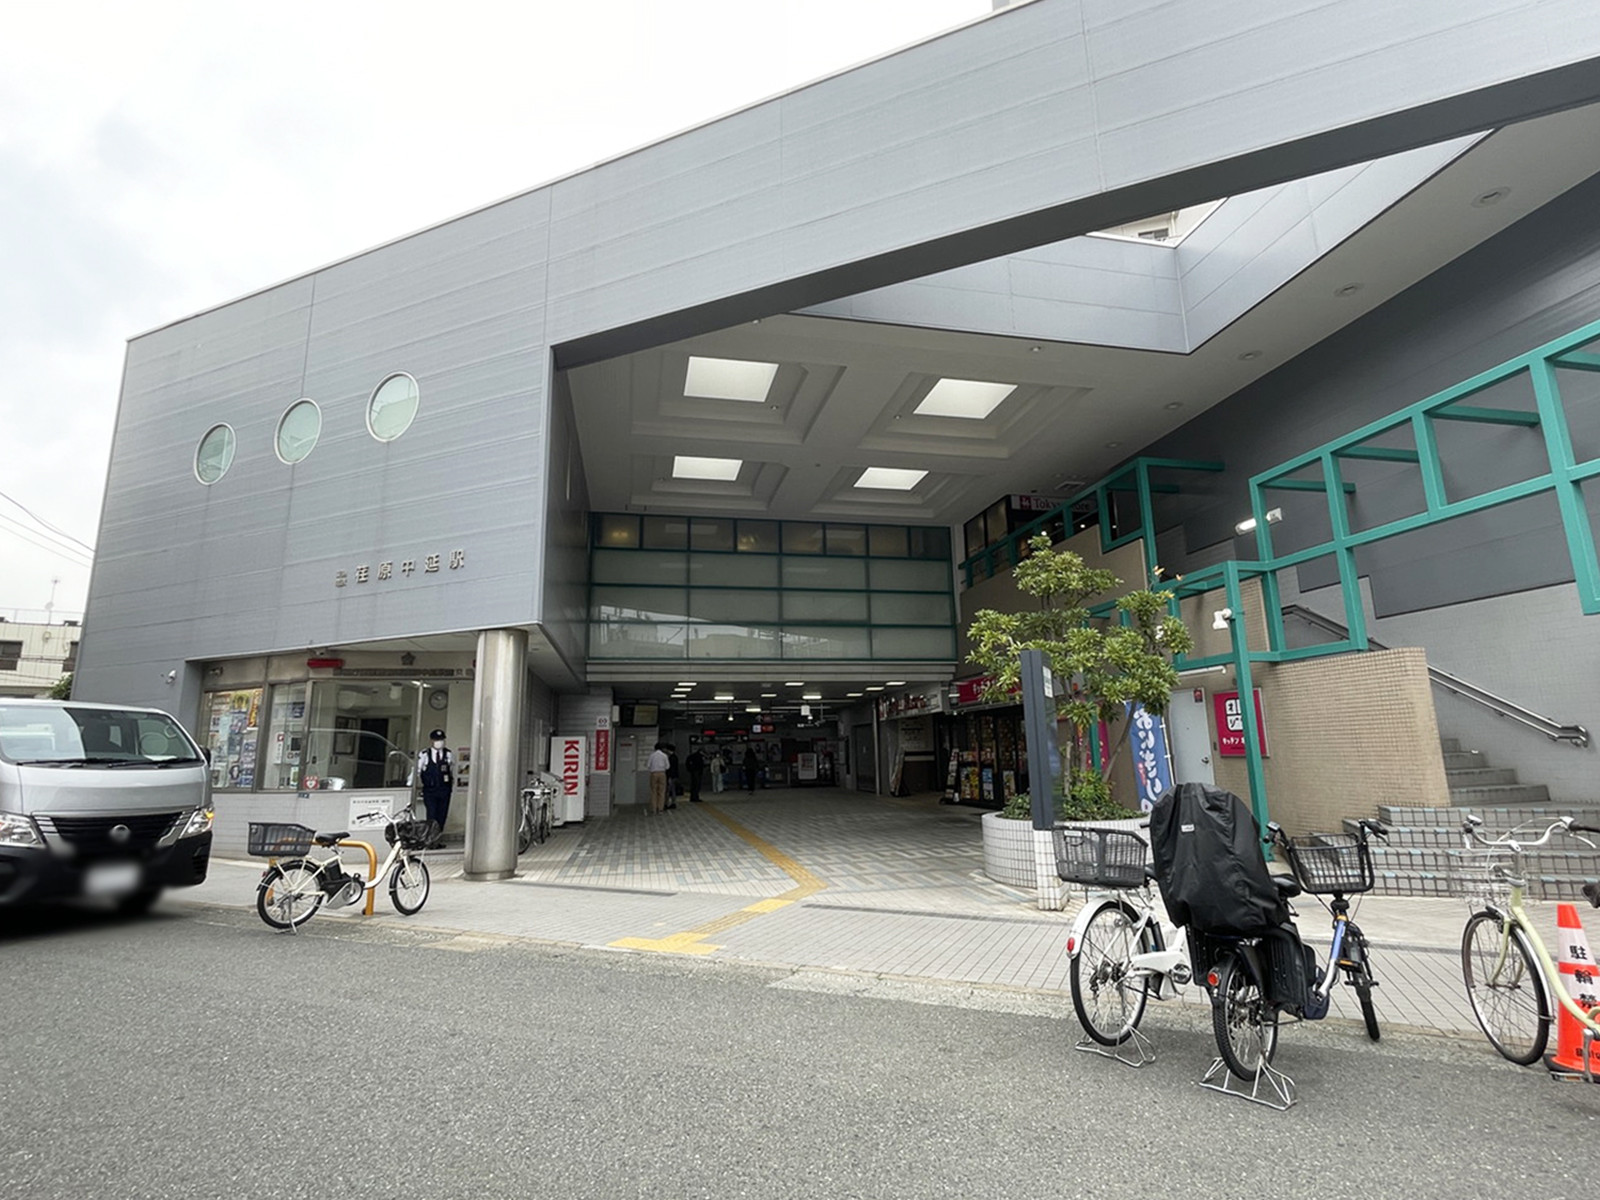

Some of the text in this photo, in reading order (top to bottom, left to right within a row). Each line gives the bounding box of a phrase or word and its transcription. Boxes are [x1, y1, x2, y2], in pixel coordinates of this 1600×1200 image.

[1033, 497, 1061, 509] Toky
[355, 549, 465, 584] 荏原中延駅
[1222, 736, 1239, 745] キッチン
[563, 740, 579, 796] KIRIN
[1569, 945, 1598, 1009] 駐輪禁
